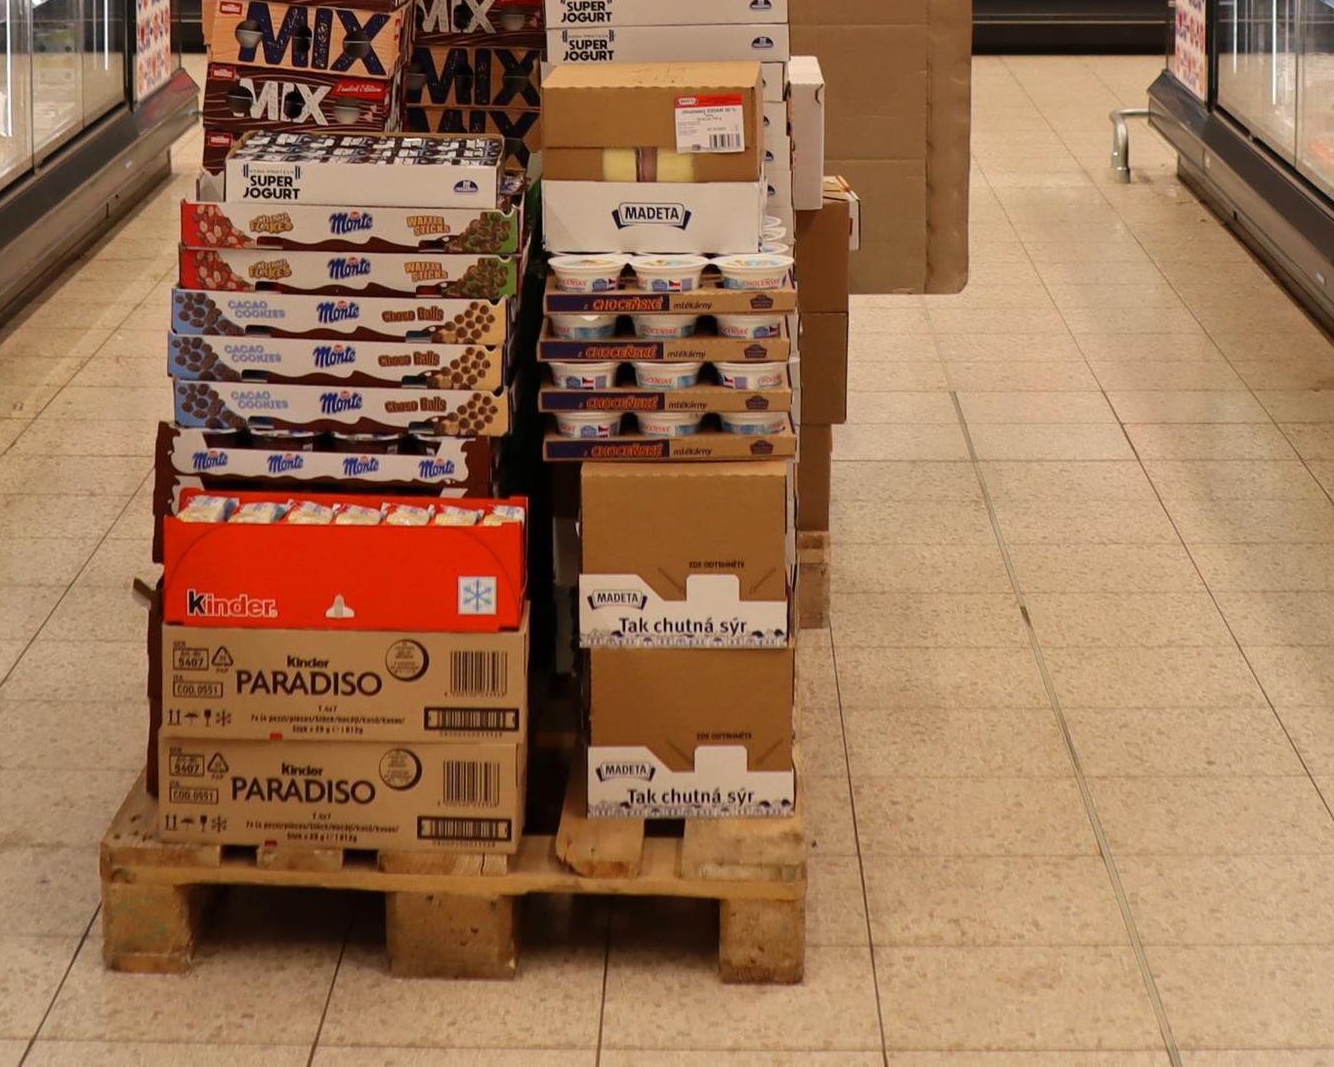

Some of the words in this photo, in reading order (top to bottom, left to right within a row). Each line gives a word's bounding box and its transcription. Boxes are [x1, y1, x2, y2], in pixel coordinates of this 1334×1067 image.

[567, 1, 607, 13] SUPER
[561, 12, 613, 24] JOGURT
[238, 1, 391, 76] MIX
[569, 39, 608, 51] SUPER
[563, 50, 615, 62] JOGURT
[410, 47, 541, 105] MIX
[231, 77, 332, 127] MIX
[249, 174, 294, 187] SUPER
[243, 187, 301, 200] JOGURT
[624, 206, 680, 222] MADETA
[329, 212, 373, 234] Monte
[327, 259, 371, 280] Monte
[228, 299, 267, 310] CACAO
[592, 295, 664, 311] CHOCEŇSKÉ
[673, 300, 713, 311] mlékárny
[234, 308, 286, 319] COOKIES
[316, 301, 361, 324] Monte
[224, 344, 264, 355] CACAO
[313, 345, 356, 368] Monte
[667, 349, 706, 360] mlékárny
[231, 352, 282, 363] COOKIES
[230, 390, 271, 401] CACAO
[320, 391, 363, 413] Monte
[238, 398, 289, 410] COOKIES
[668, 400, 708, 411] mlékárny
[673, 447, 713, 458] mlékárny
[192, 450, 229, 470] Monte
[267, 453, 304, 473] Monte
[342, 455, 379, 476] Monte
[418, 458, 456, 479] Monte
[597, 591, 640, 604] MADETA
[619, 617, 649, 634] Tak
[653, 615, 715, 635] chutná
[718, 616, 748, 637] sýr
[178, 657, 204, 668] 5407
[235, 671, 384, 697] PARADISO
[605, 764, 648, 776] MADETA
[231, 777, 376, 805] PARADISO
[627, 788, 657, 806] Tak
[660, 787, 723, 806] chutná
[725, 787, 756, 807] sýr
